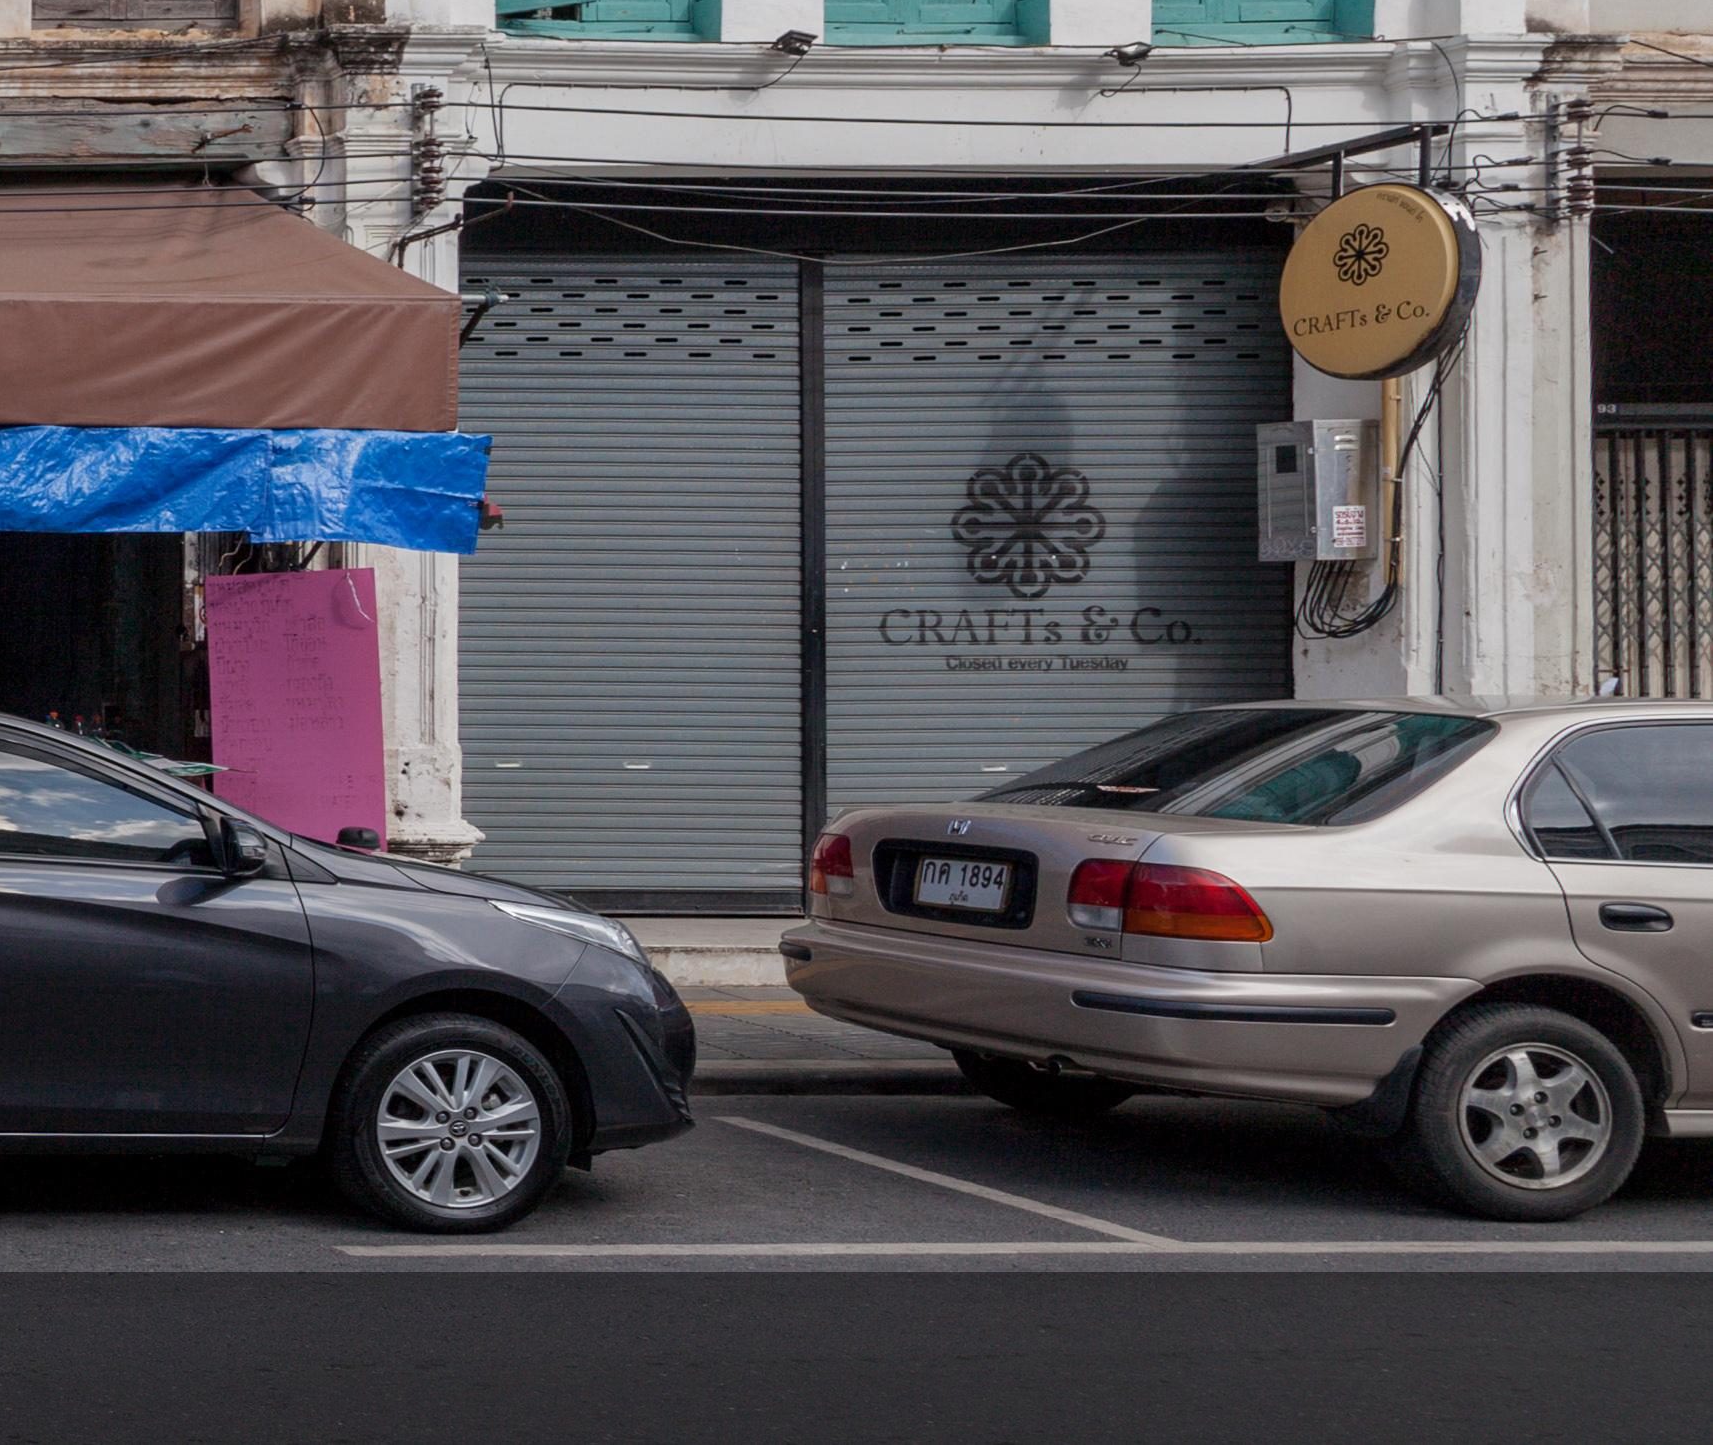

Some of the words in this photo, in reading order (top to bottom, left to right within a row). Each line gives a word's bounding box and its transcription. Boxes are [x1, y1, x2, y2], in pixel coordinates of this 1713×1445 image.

[1293, 309, 1368, 337] CRAFTs
[1375, 303, 1392, 324] &
[1396, 300, 1430, 321] Co.
[1597, 403, 1617, 414] 93
[878, 607, 1063, 646] CRAFTs
[1081, 605, 1119, 646] &
[1129, 606, 1202, 646] Co.
[945, 655, 1003, 671] Closed
[1008, 658, 1053, 672] every
[1060, 655, 1129, 672] Tuesday
[923, 861, 951, 886] กค
[961, 863, 1005, 890] 1894
